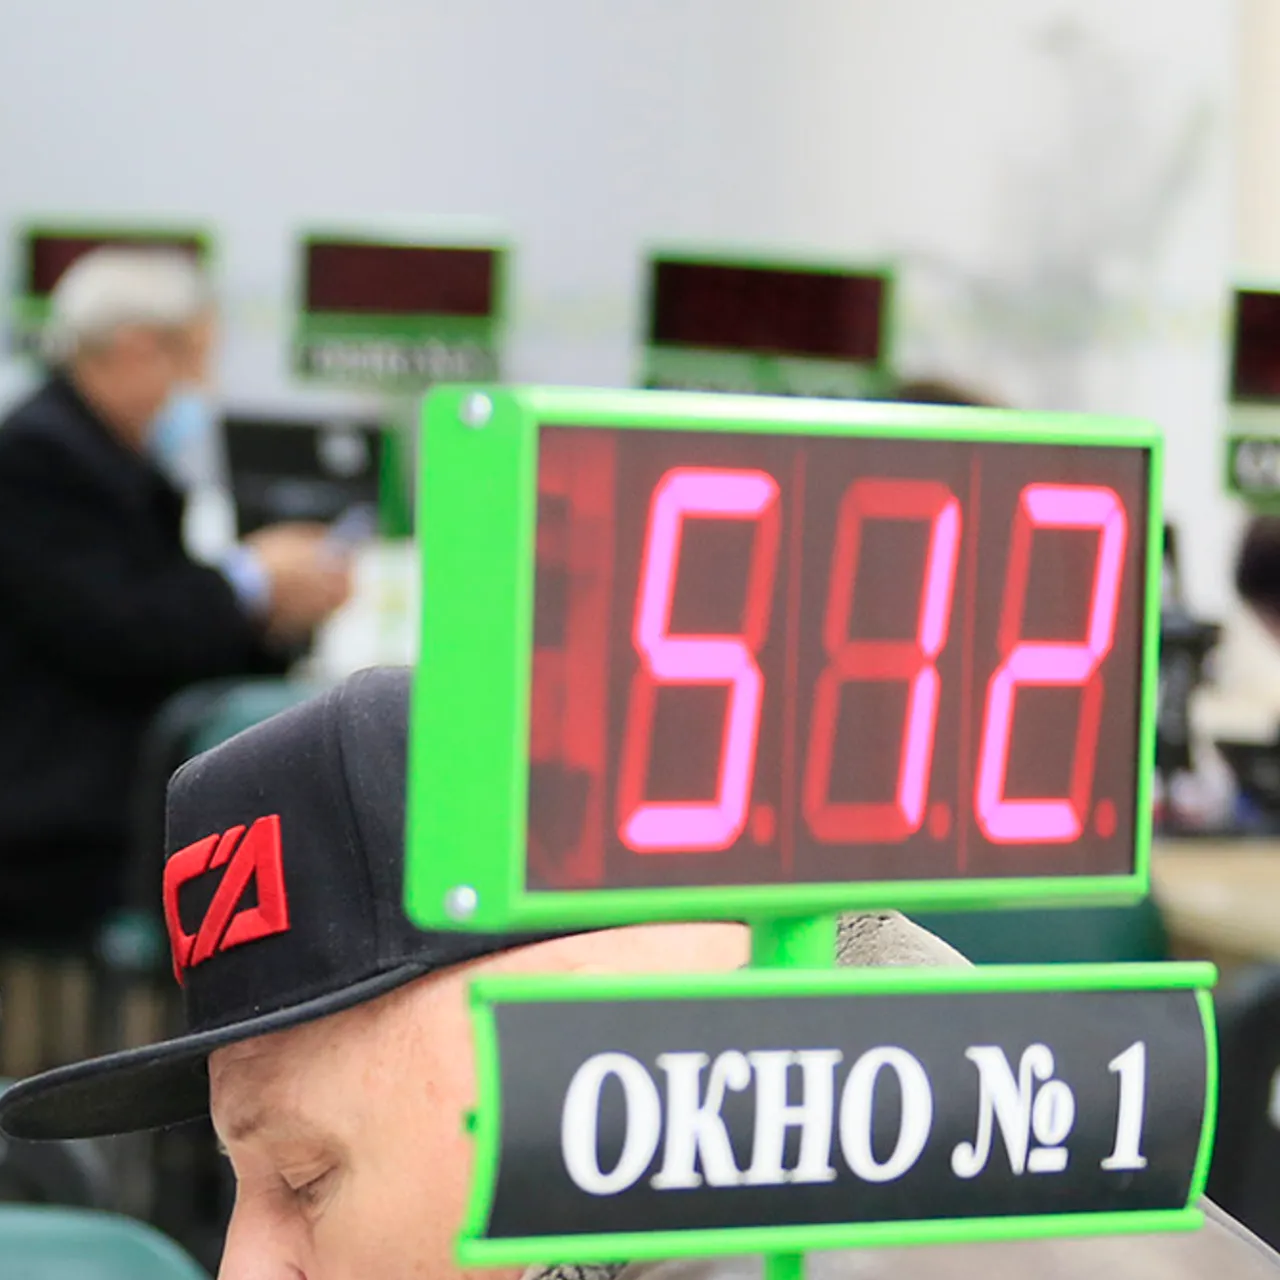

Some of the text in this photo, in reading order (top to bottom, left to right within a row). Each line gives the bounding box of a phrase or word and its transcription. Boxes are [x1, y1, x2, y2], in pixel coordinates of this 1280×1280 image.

[619, 467, 1126, 853] 512
[561, 1042, 1147, 1195] ОКНО № 1
